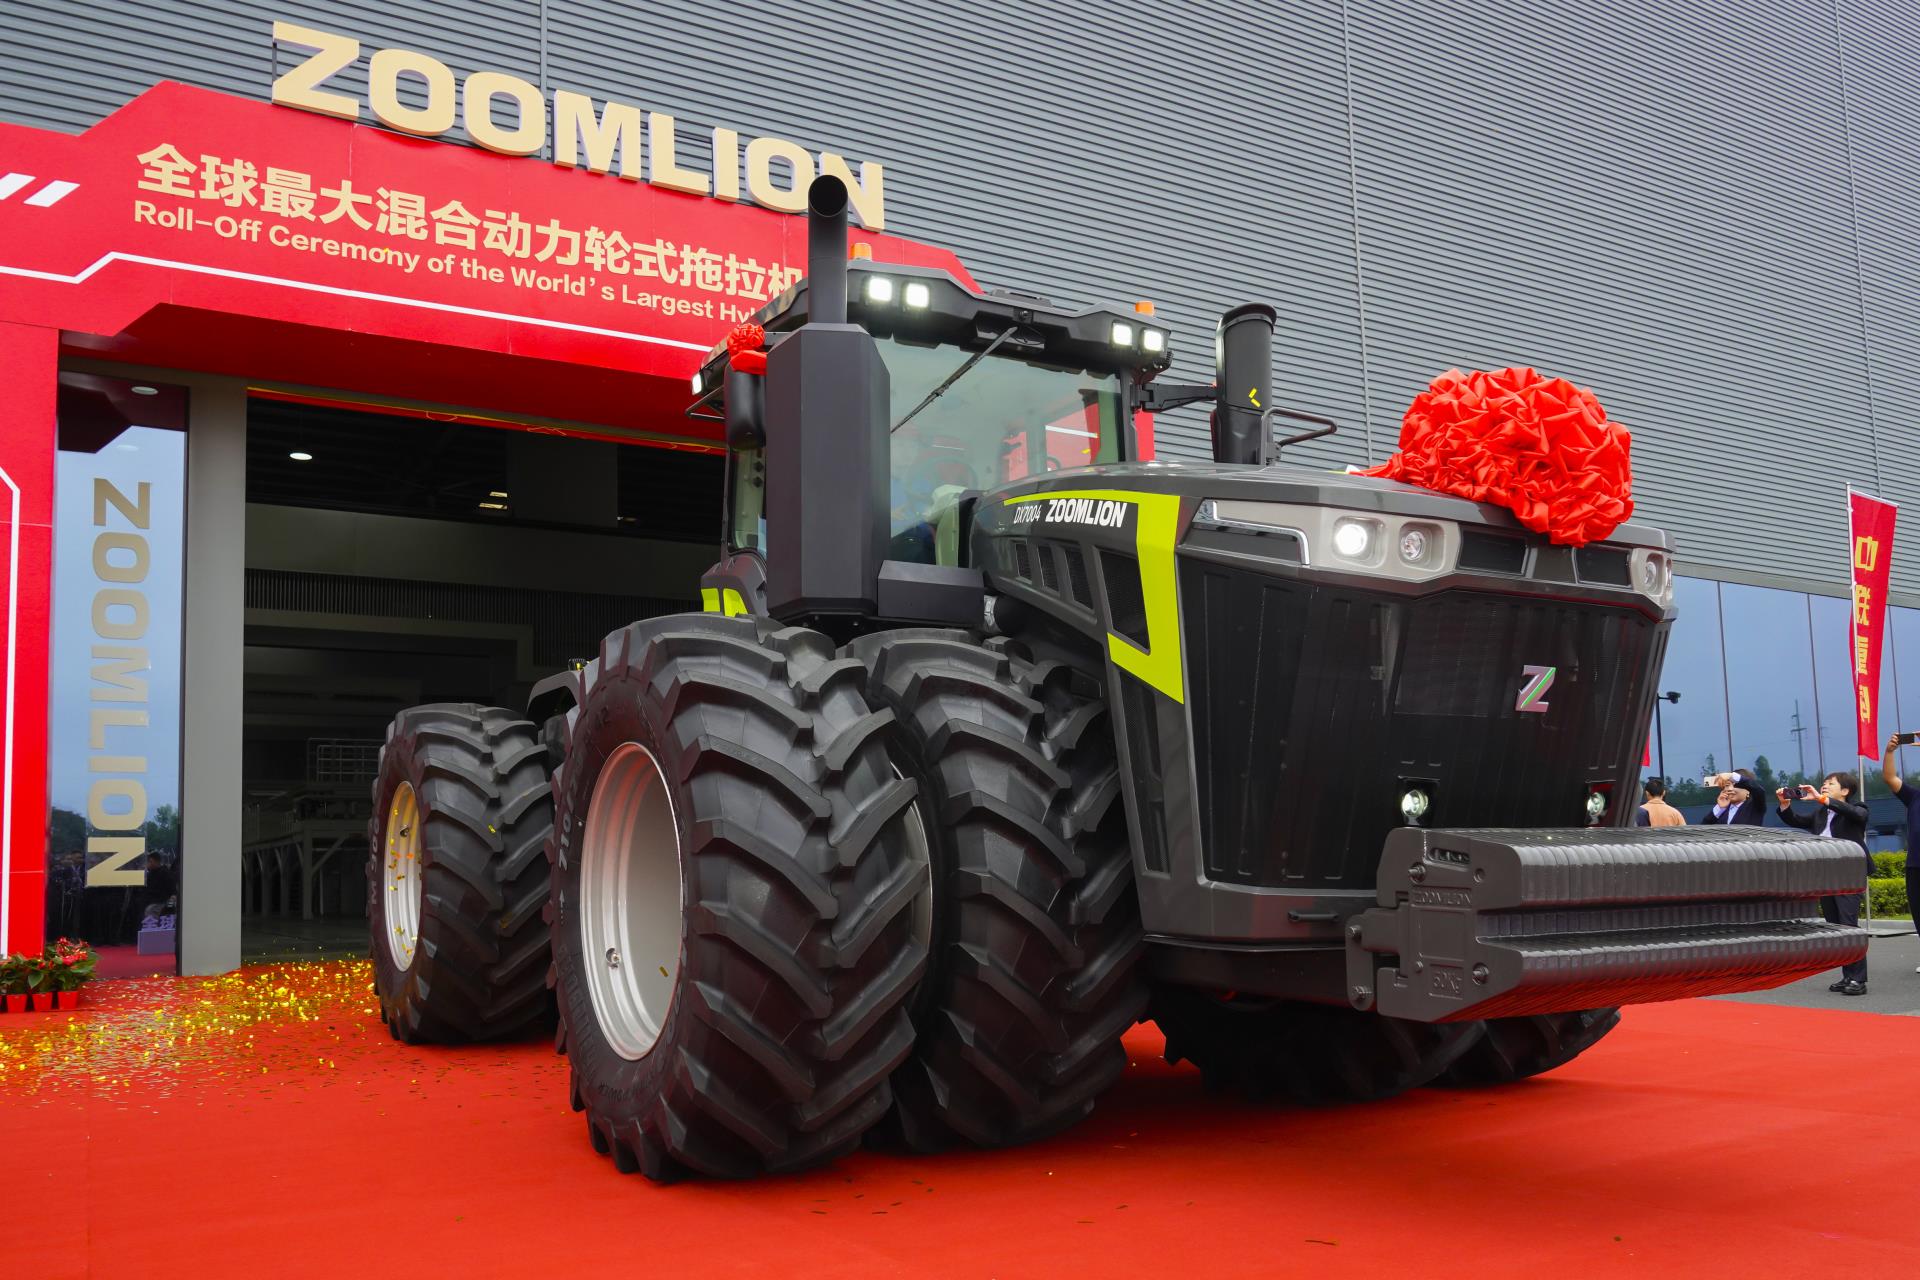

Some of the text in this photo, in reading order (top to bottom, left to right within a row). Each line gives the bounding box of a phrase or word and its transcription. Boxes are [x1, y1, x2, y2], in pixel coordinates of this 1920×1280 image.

[272, 20, 885, 233] ZOOMLION
[136, 142, 803, 302] 全球最大混合动力轮式拖拉机
[268, 224, 420, 274] Ceremony
[427, 254, 455, 275] of
[460, 256, 505, 284] the
[622, 283, 714, 319] Largest
[1013, 498, 1128, 528] DX7004 ZOOMLION
[86, 477, 152, 888] ZOOMLION
